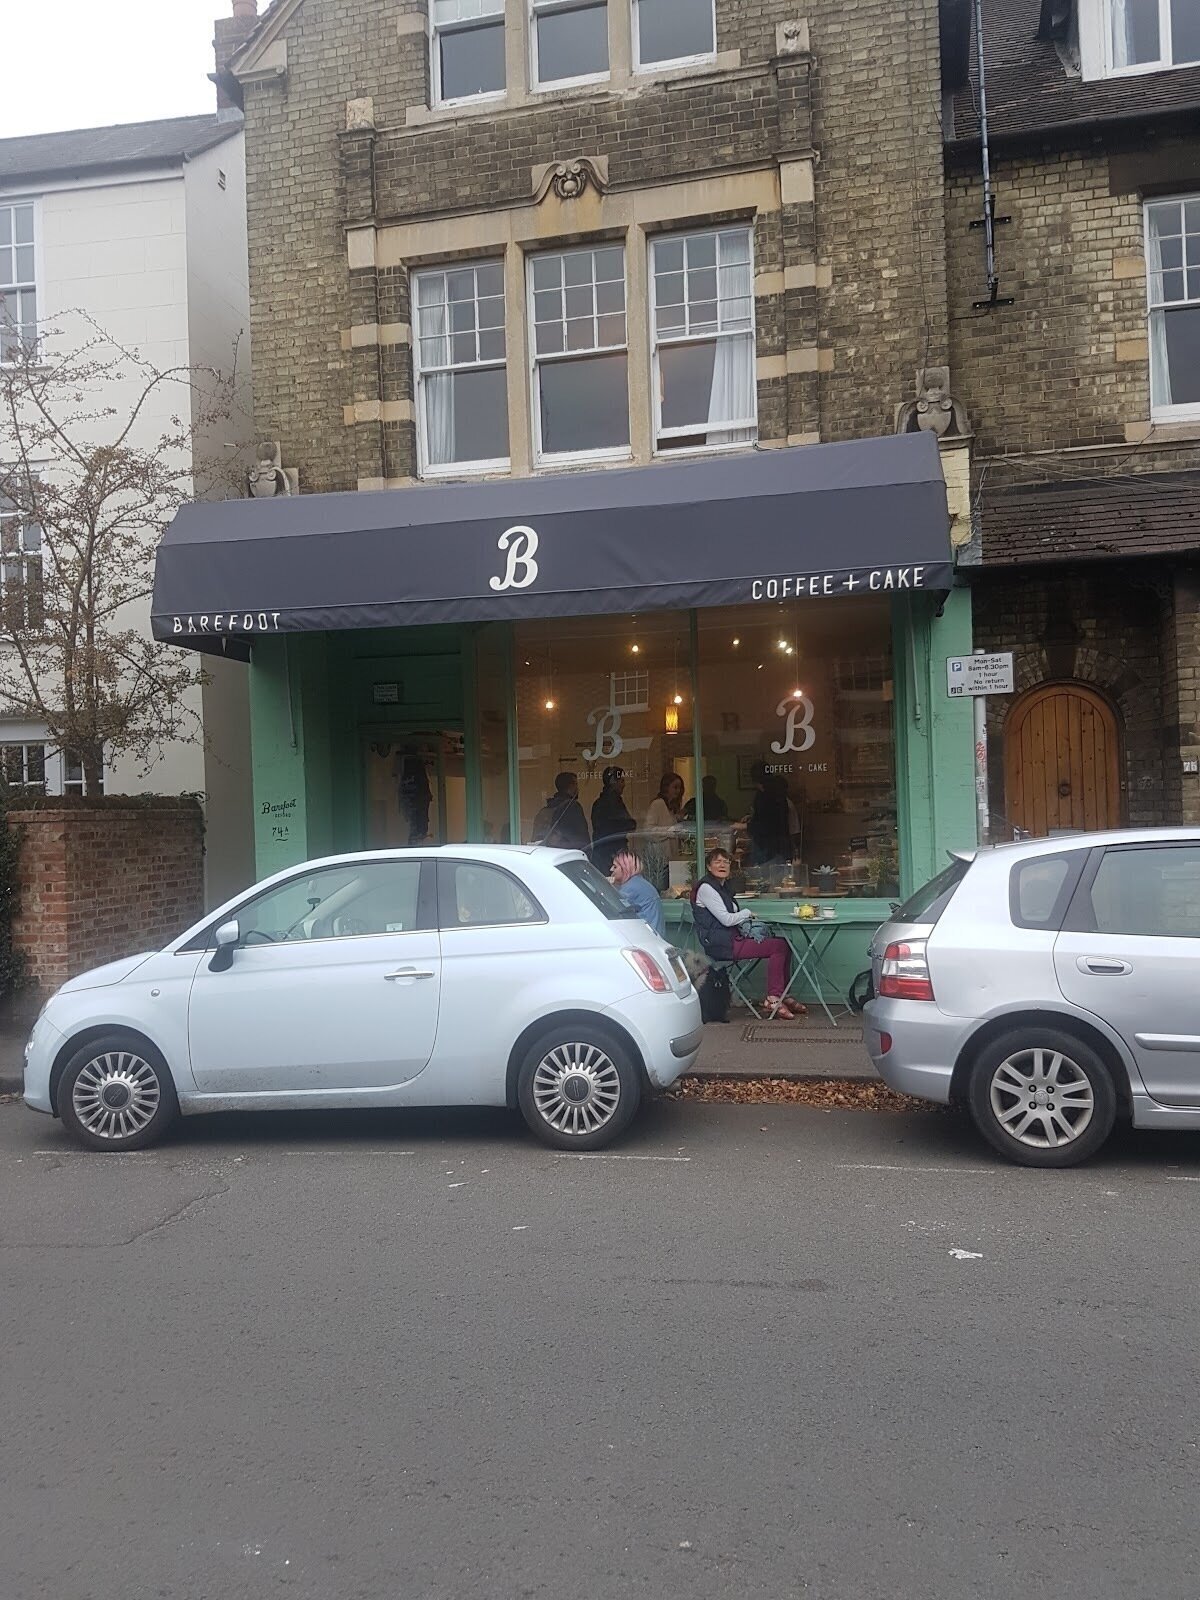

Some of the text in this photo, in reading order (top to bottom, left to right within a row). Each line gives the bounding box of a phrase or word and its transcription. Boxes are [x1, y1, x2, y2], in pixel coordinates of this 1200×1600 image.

[489, 525, 539, 591] B
[752, 575, 834, 600] COFFEE
[869, 567, 924, 590] CAKE
[173, 613, 280, 633] BAREFOOT
[968, 683, 988, 691] within
[582, 705, 623, 761] B
[771, 695, 816, 754] B
[577, 771, 603, 780] COFFEE
[616, 769, 633, 779] CAKE
[764, 764, 793, 774] COFFEE
[808, 763, 828, 772] CAKE
[261, 799, 297, 815] Barefoot
